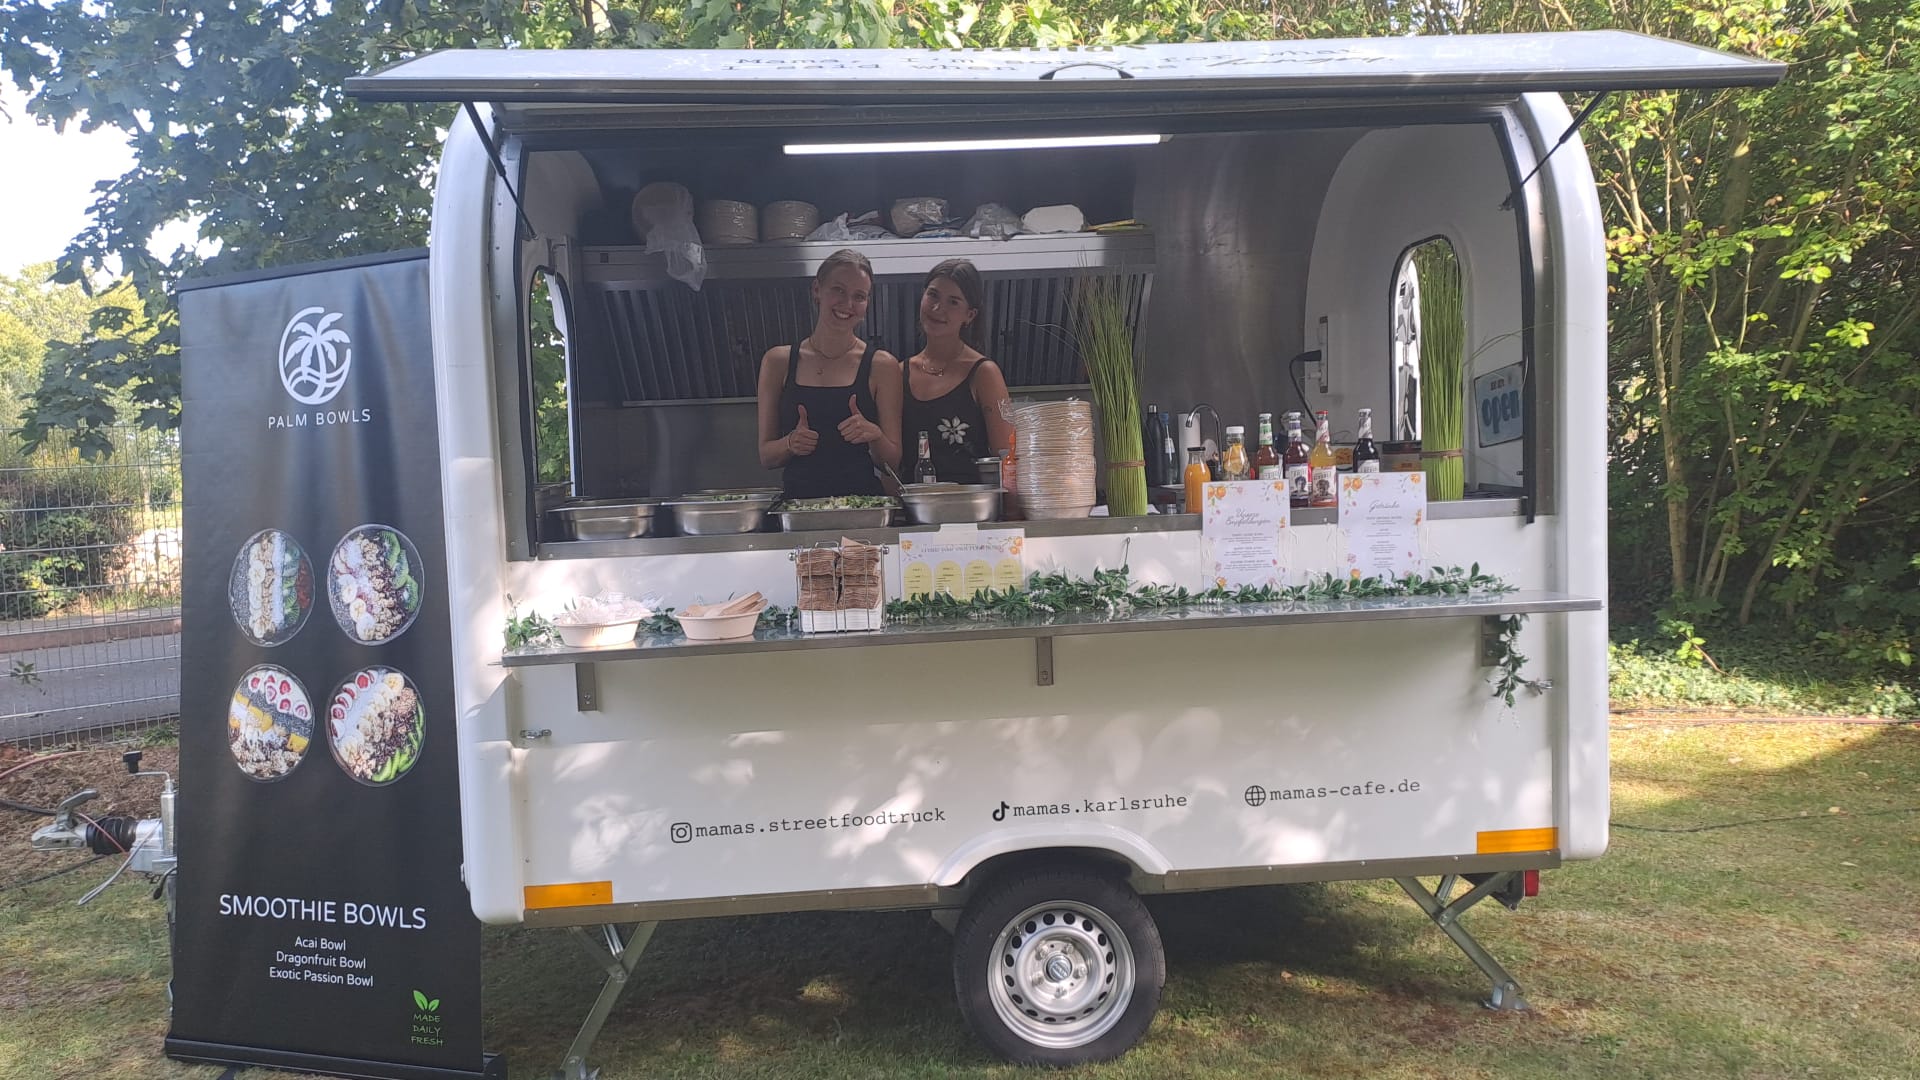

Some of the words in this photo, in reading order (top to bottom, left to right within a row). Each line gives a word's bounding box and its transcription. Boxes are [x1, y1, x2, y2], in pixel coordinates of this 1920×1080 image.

[268, 413, 307, 429] PALM
[316, 408, 371, 425] BOWLS
[1481, 389, 1521, 434] open
[1269, 778, 1421, 801] mamas-cafe.de
[1013, 793, 1188, 817] mamas.karlsruhe
[695, 808, 946, 838] mamas.streetfoodtruck
[219, 894, 337, 923] SMOOTHIE
[344, 902, 427, 930] BOWLS
[295, 936, 318, 949] Acai
[320, 937, 346, 951] Bowl
[276, 951, 337, 968] Dragonfruit
[339, 956, 366, 969] Bowl
[269, 967, 301, 980] Exotic
[304, 970, 344, 985] Passion
[347, 974, 374, 987] Bowl
[413, 1013, 441, 1023] MADE
[413, 1025, 441, 1036] DAILY
[410, 1036, 443, 1046] FRESH
